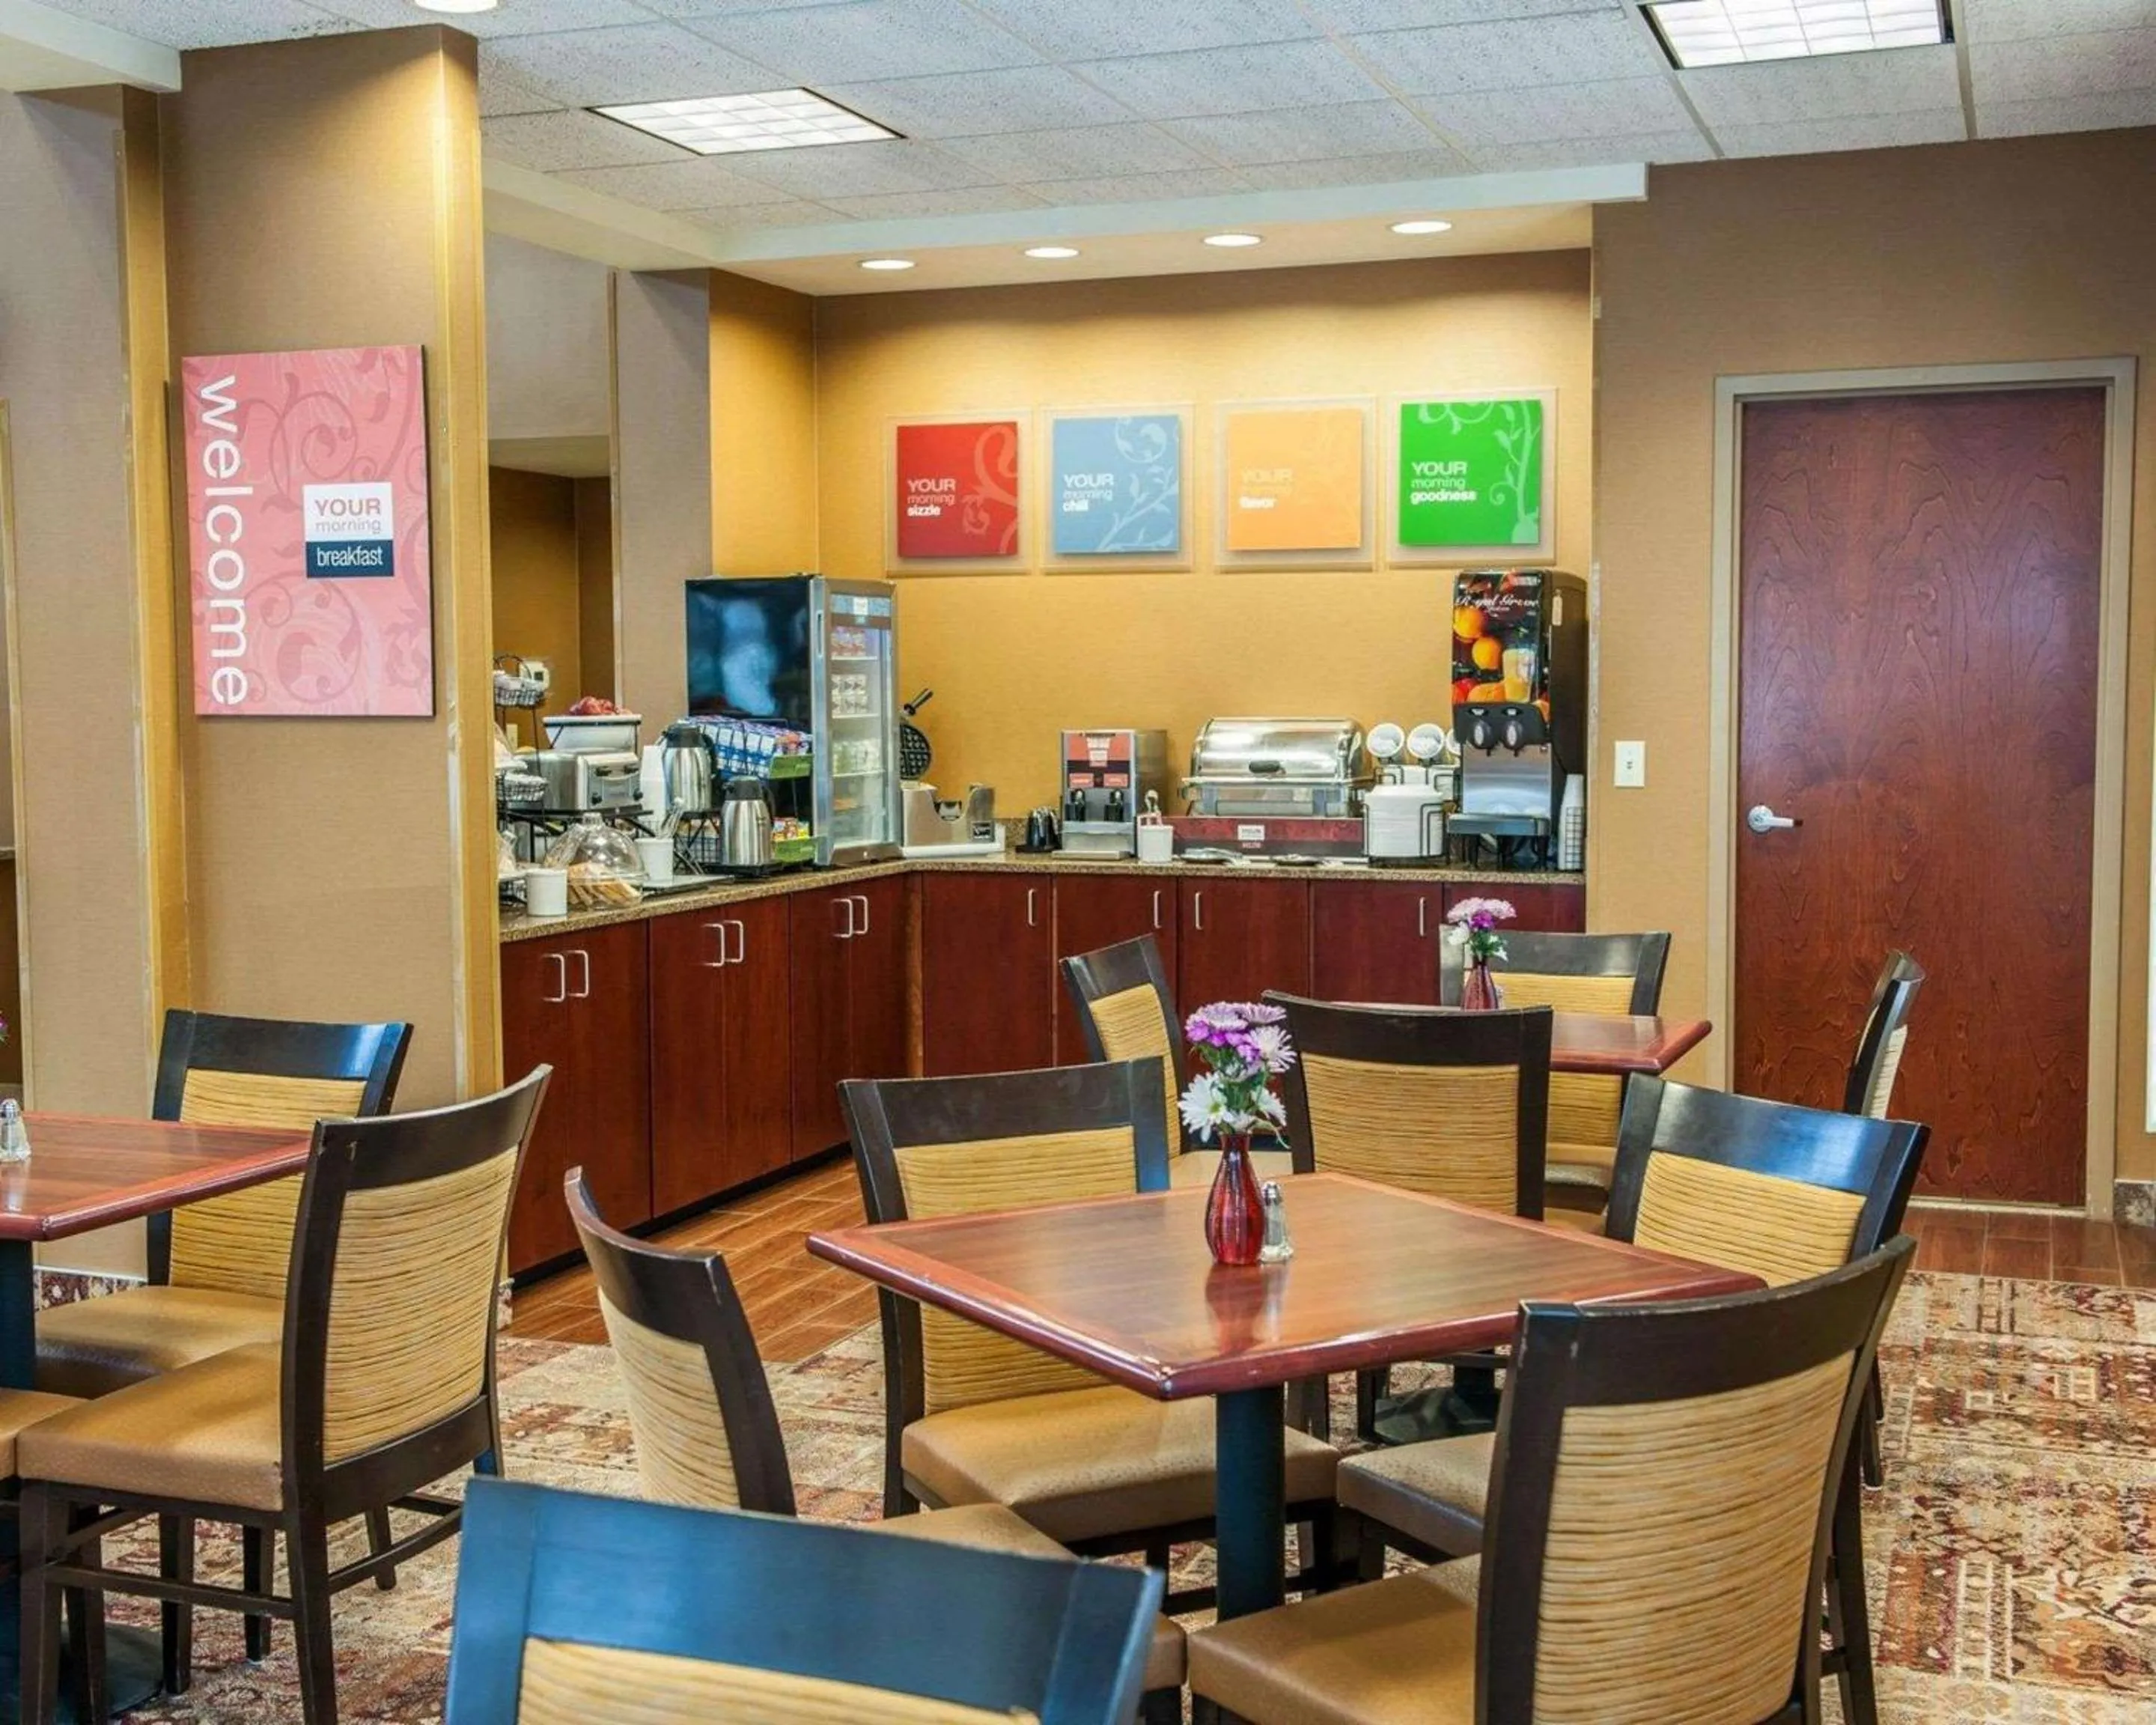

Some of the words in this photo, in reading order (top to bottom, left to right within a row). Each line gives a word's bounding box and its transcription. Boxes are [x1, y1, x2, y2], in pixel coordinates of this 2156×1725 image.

[1411, 460, 1467, 475] YOUR
[907, 478, 956, 493] YOUR
[1064, 473, 1114, 488] YOUR
[1410, 477, 1466, 491] morning
[907, 493, 955, 506] morning
[1410, 489, 1477, 505] goodness
[314, 498, 381, 517] YOUR
[315, 519, 381, 535] morning
[201, 375, 254, 706] welcome
[317, 545, 383, 566] breakfast
